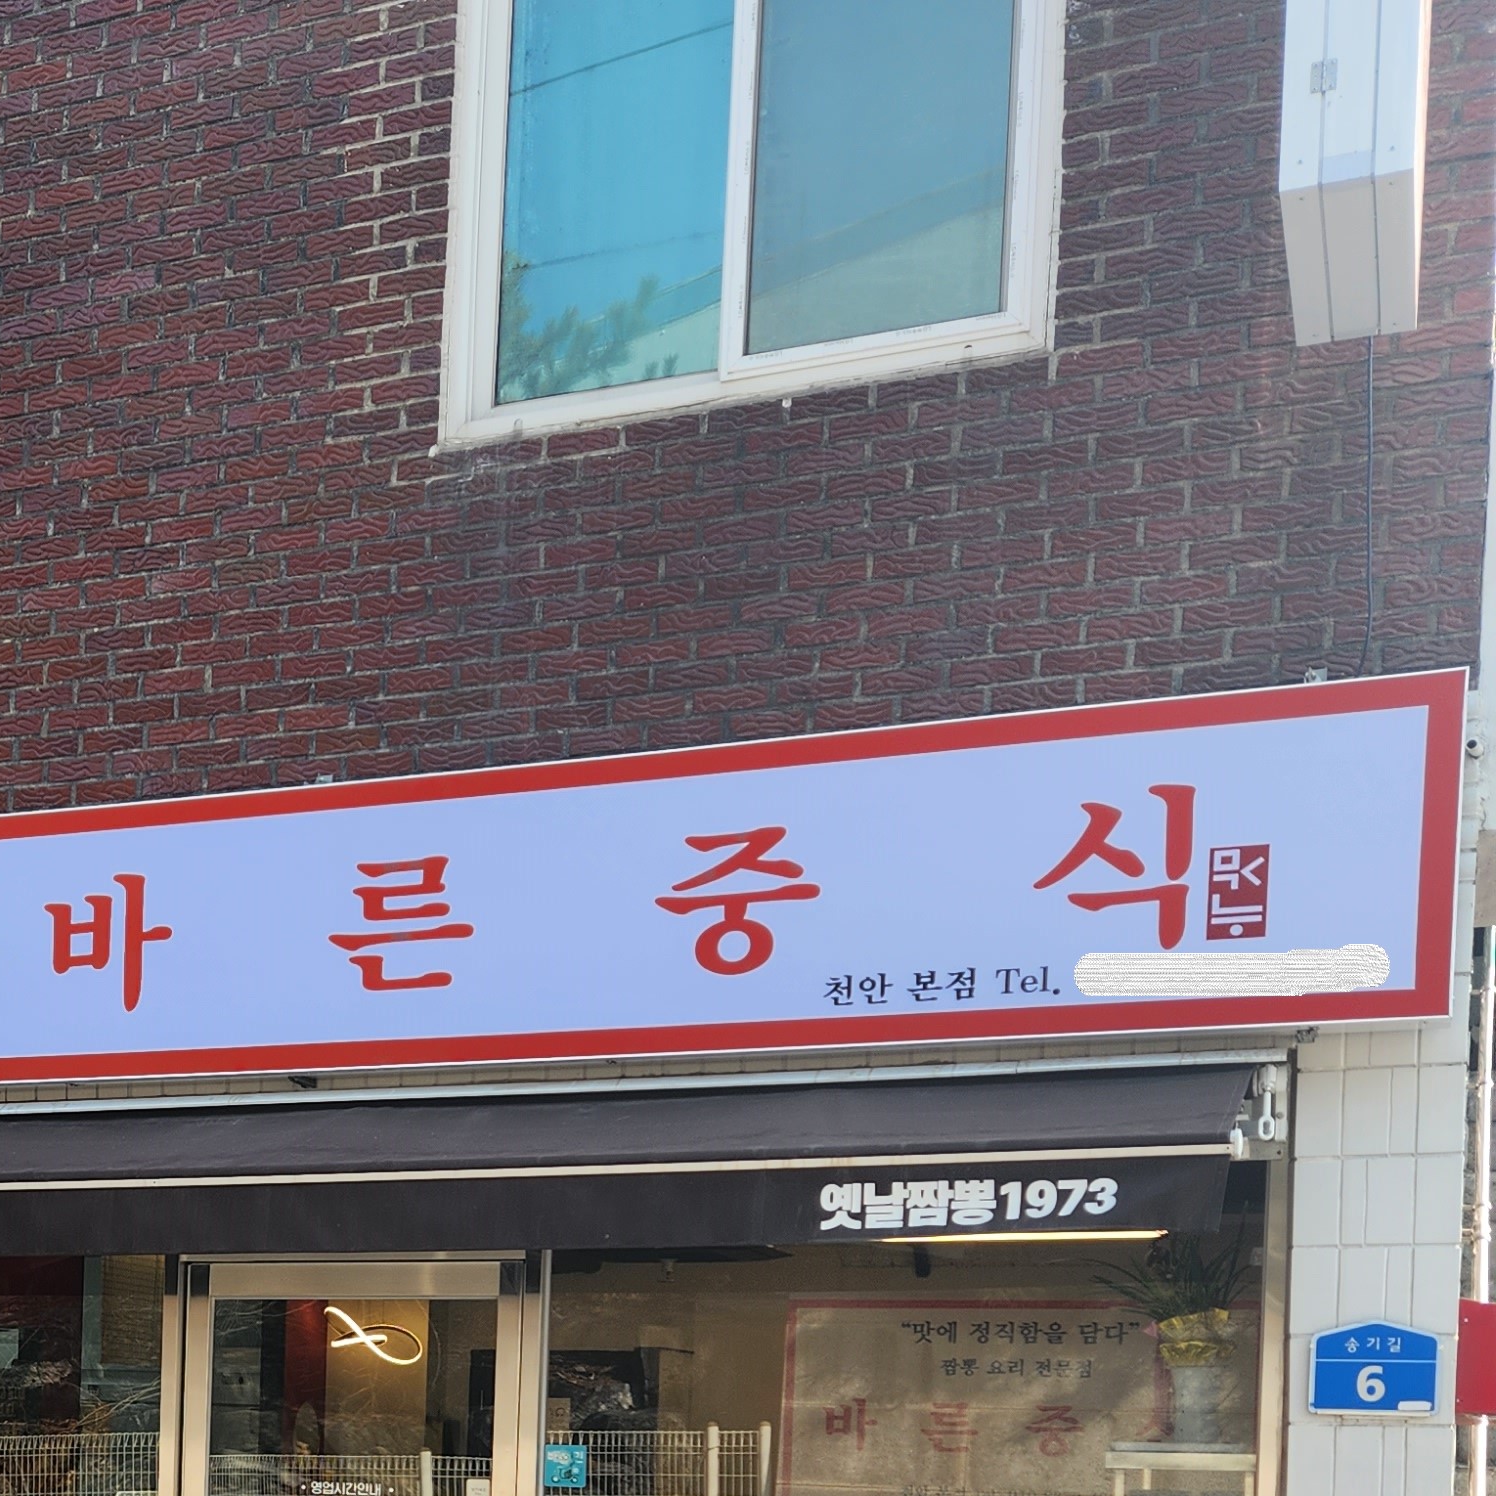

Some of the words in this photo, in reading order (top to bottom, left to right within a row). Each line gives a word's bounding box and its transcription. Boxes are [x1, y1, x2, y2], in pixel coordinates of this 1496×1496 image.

[823, 972, 894, 1006] 천안
[906, 967, 977, 1002] 본점
[995, 965, 1061, 996] Tel.
[968, 1320, 1068, 1345] 정직함을
[1344, 1337, 1402, 1353] 송기길
[986, 1360, 1025, 1378] 요리
[1034, 1359, 1094, 1379] 전문점
[1356, 1365, 1386, 1402] 6
